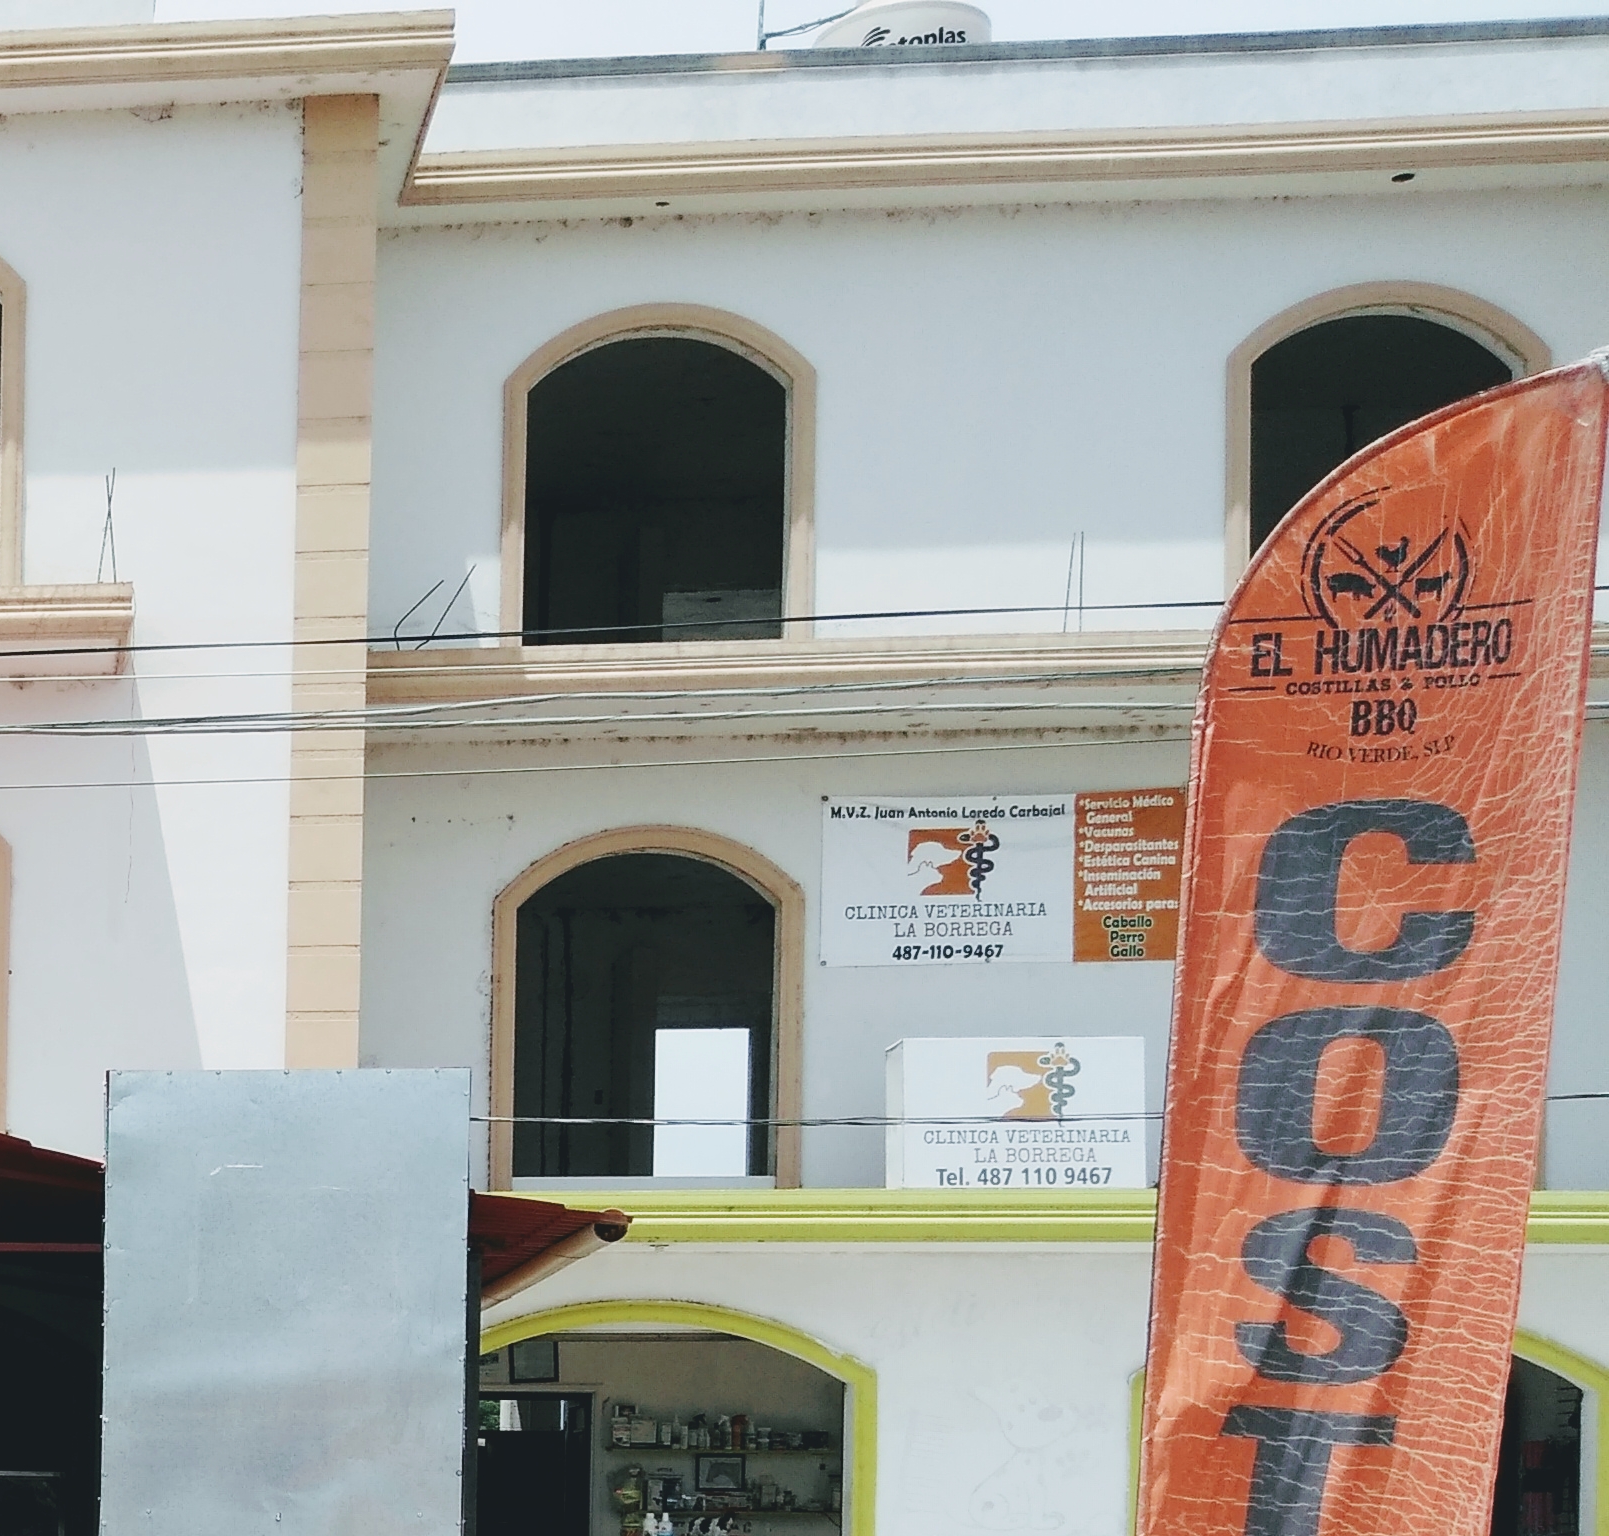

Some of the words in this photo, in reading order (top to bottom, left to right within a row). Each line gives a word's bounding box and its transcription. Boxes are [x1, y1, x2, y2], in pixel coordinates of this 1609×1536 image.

[1251, 633, 1292, 677] EL
[1314, 618, 1511, 675] HUMADERO
[1286, 678, 1390, 695] COSTILLAS
[1400, 677, 1413, 690] &
[1423, 673, 1481, 689] POLLO
[1350, 698, 1417, 736] BBQ
[1307, 741, 1340, 761] RIO
[1084, 798, 1130, 810] Servicio
[1132, 795, 1175, 808] Médico
[830, 806, 871, 819] M.V.Z.
[875, 806, 904, 820] Juan
[908, 806, 958, 819] Antonio
[962, 806, 1005, 819] Loredo
[1009, 803, 1066, 820] Carbajal
[1086, 810, 1133, 824] General
[1084, 826, 1134, 838] Vacunas
[1084, 839, 1179, 855] Desparasitantes
[1083, 854, 1130, 867] Estética
[1133, 853, 1176, 866] Canina
[1083, 867, 1161, 882] Inseminación
[1084, 882, 1138, 896] Artificial
[845, 905, 919, 920] CLINICA
[924, 902, 1047, 919] VETERINARIA
[1082, 897, 1143, 911] Accesorios
[893, 922, 917, 938] LA
[924, 921, 1013, 937] BORREGA
[1103, 915, 1153, 929] Caballo
[1110, 930, 1145, 943] Perro
[892, 944, 1004, 961] 487-110-9467
[1110, 944, 1145, 957] Gallo
[923, 1130, 999, 1145] CLINICA
[1005, 1129, 1131, 1144] VETERINARIA
[974, 1148, 998, 1164] LA
[1005, 1147, 1097, 1163] BORREGA
[935, 1167, 970, 1186] Tel.
[977, 1167, 1012, 1186] 487
[1021, 1167, 1056, 1185] 110
[1064, 1166, 1112, 1185] 9467
